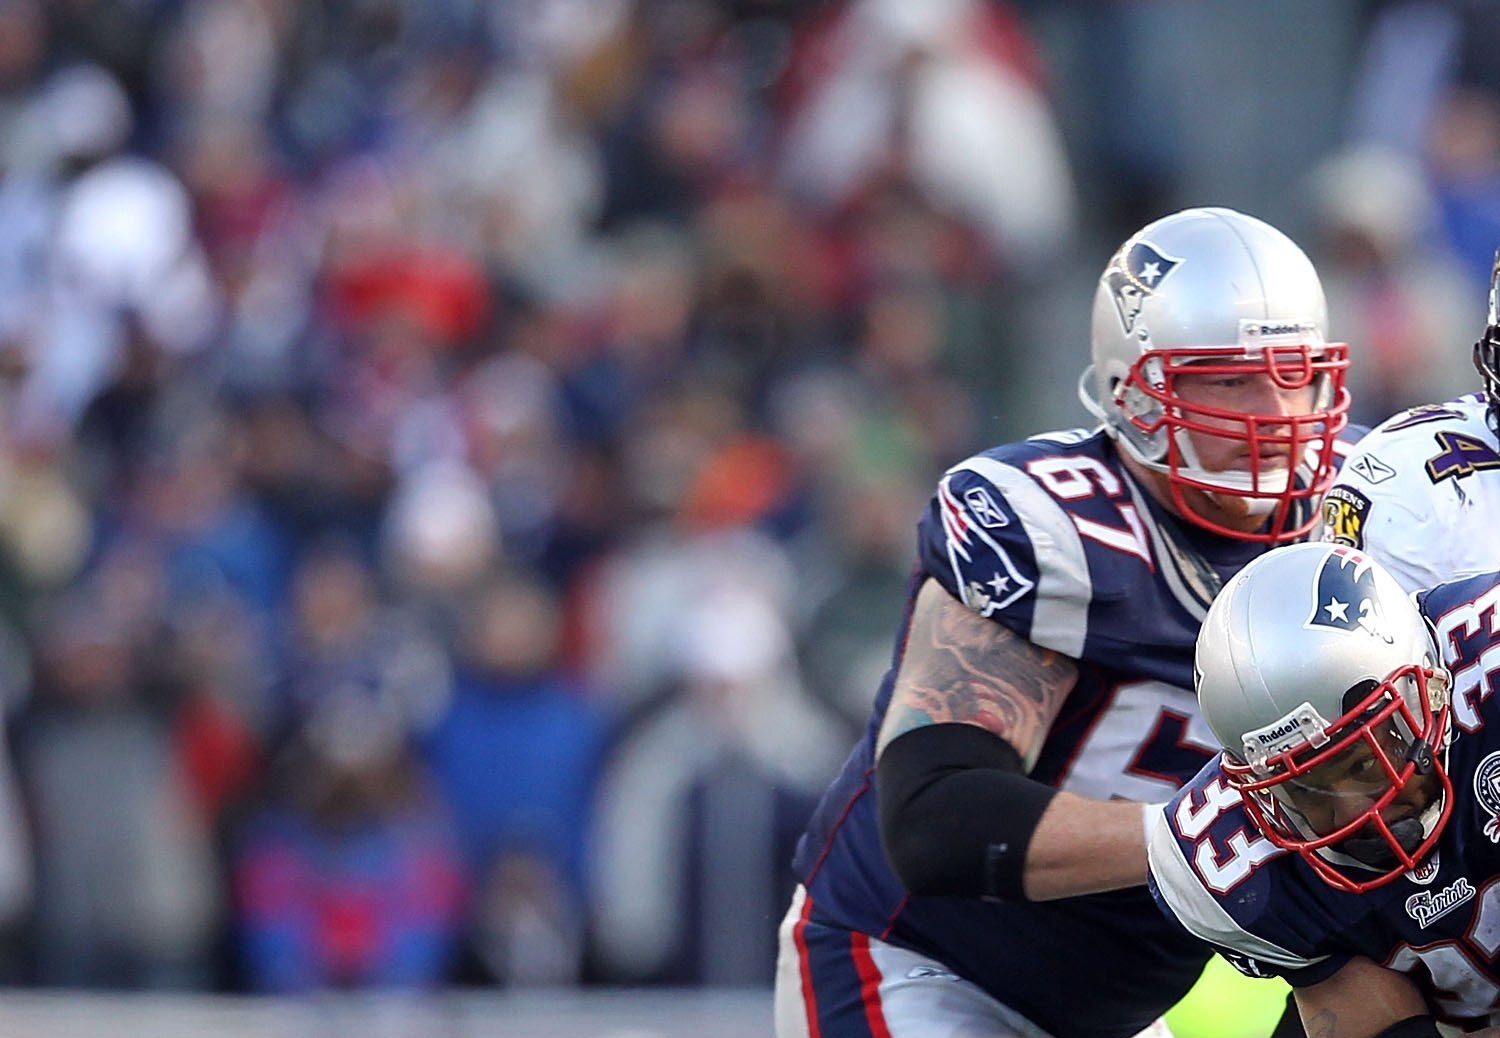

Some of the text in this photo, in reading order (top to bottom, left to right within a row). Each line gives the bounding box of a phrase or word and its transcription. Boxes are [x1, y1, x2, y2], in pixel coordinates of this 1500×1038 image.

[1024, 453, 1156, 573] 67
[1259, 718, 1300, 744] Riddell
[1412, 881, 1473, 926] Patriots
